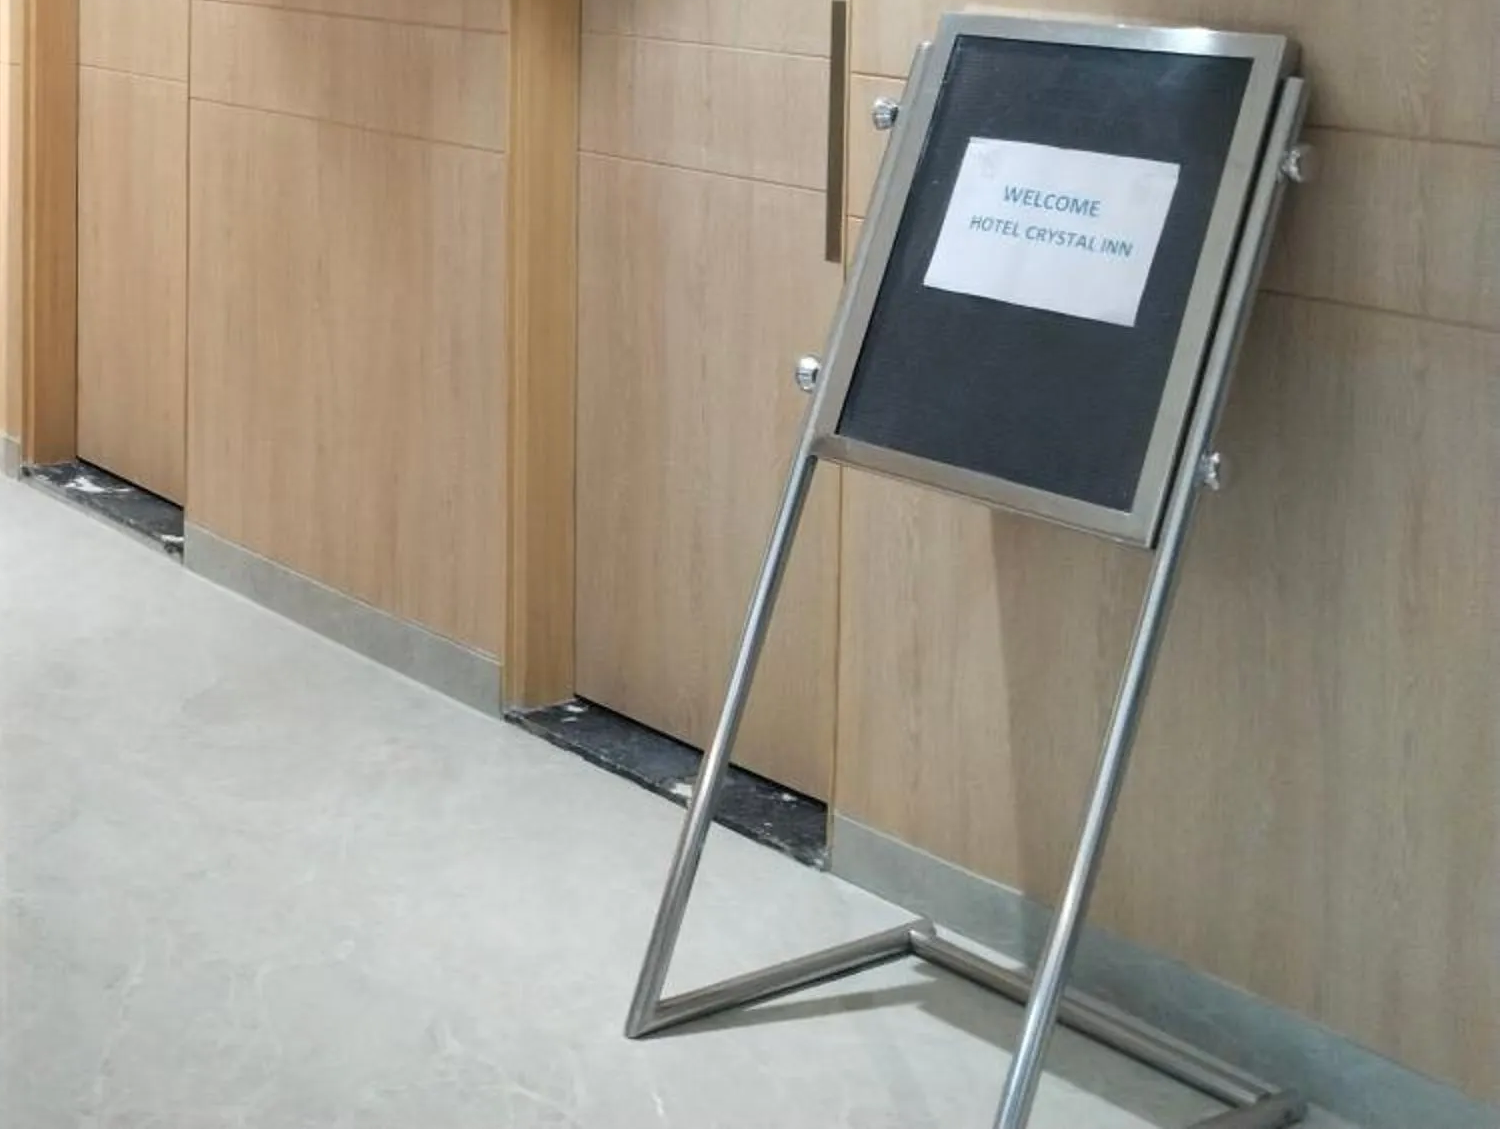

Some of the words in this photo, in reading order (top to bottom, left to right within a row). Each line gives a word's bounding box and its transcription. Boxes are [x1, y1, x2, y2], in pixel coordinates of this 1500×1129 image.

[1003, 185, 1101, 217] WELCOME
[969, 214, 1020, 238] HOTEL
[1024, 225, 1096, 252] CRYSTAL
[1100, 237, 1134, 258] INN
